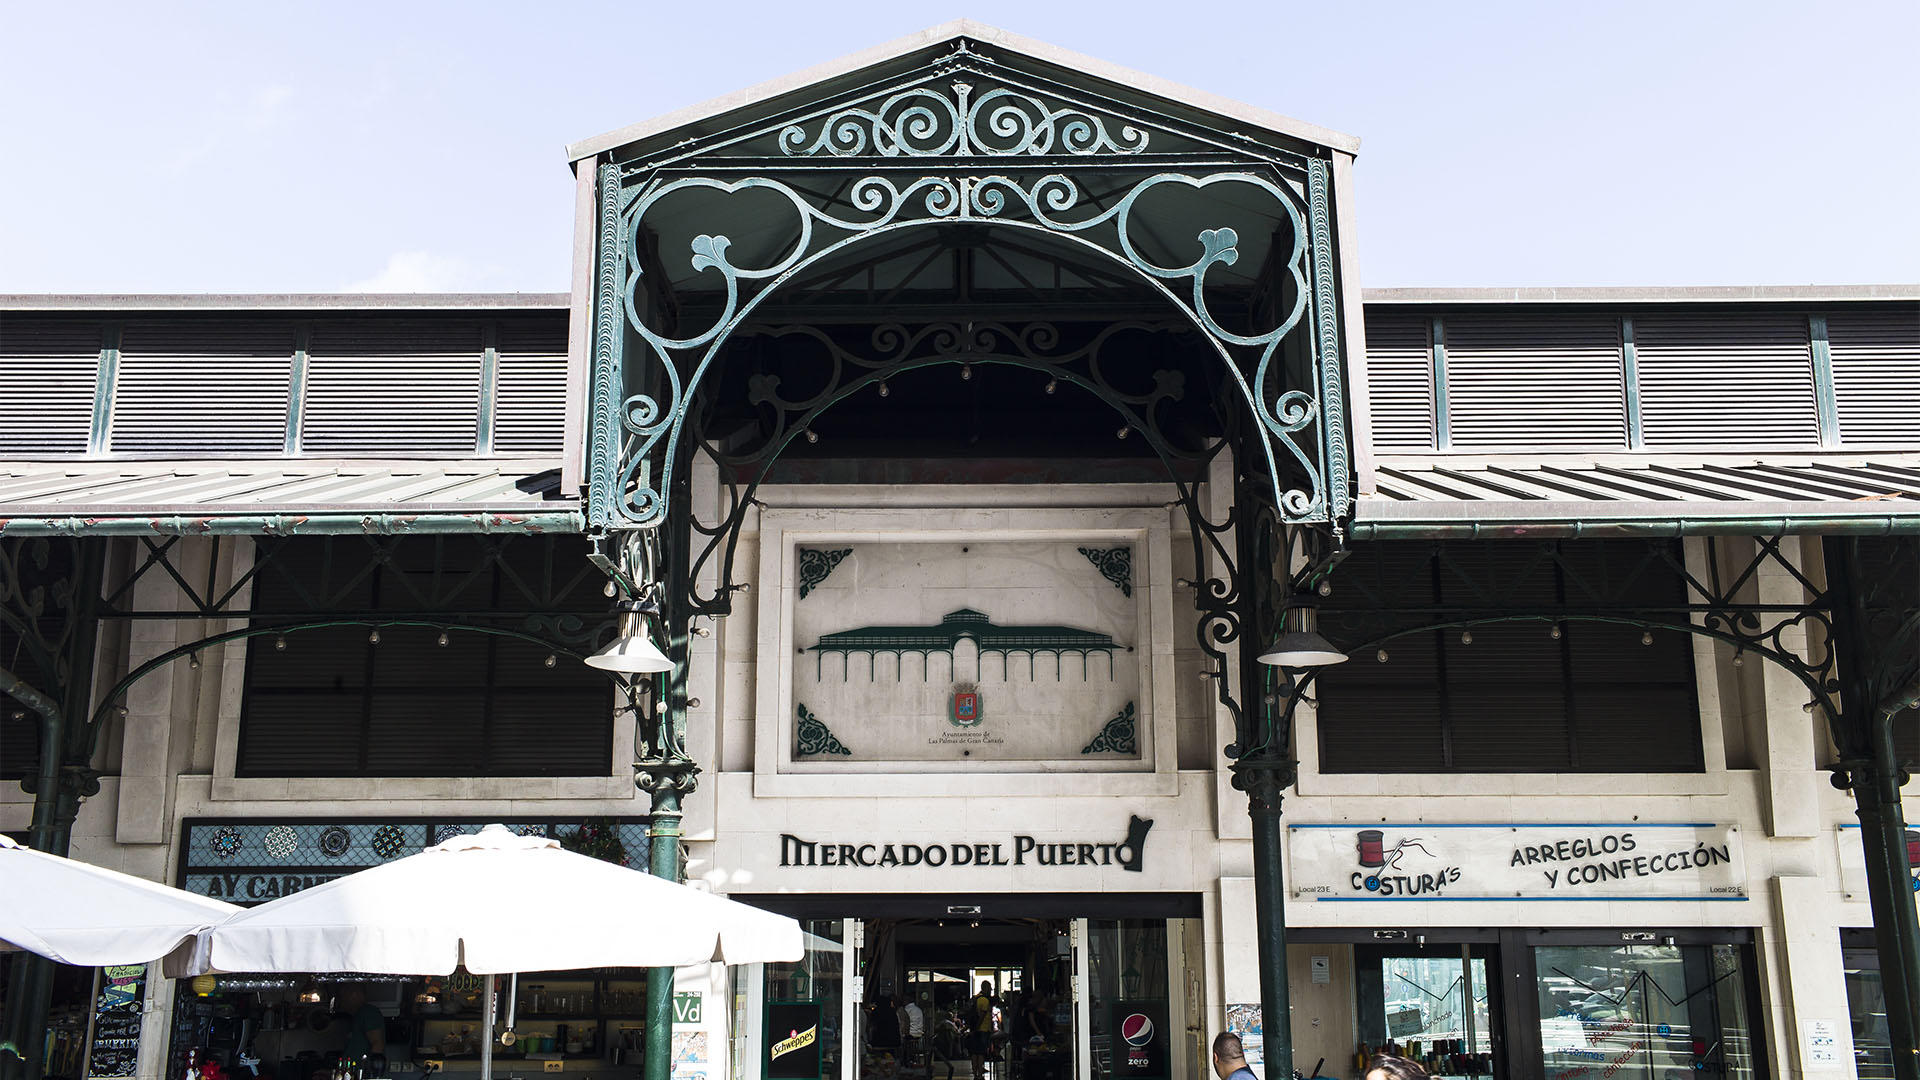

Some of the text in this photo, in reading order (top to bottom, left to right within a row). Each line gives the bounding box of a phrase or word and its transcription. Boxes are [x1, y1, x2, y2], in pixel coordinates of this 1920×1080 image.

[942, 731, 982, 739] Ayuntamiento
[779, 826, 1147, 870] MERCADO DEL PUERTO
[1510, 833, 1637, 868] ARREGLOS
[1543, 842, 1731, 889] Y CONFECCIÓN
[207, 874, 241, 898] AY
[1298, 886, 1316, 894] Local
[1709, 886, 1728, 894] Local
[774, 1030, 815, 1056] Schweppes
[1127, 1058, 1150, 1066] zero
